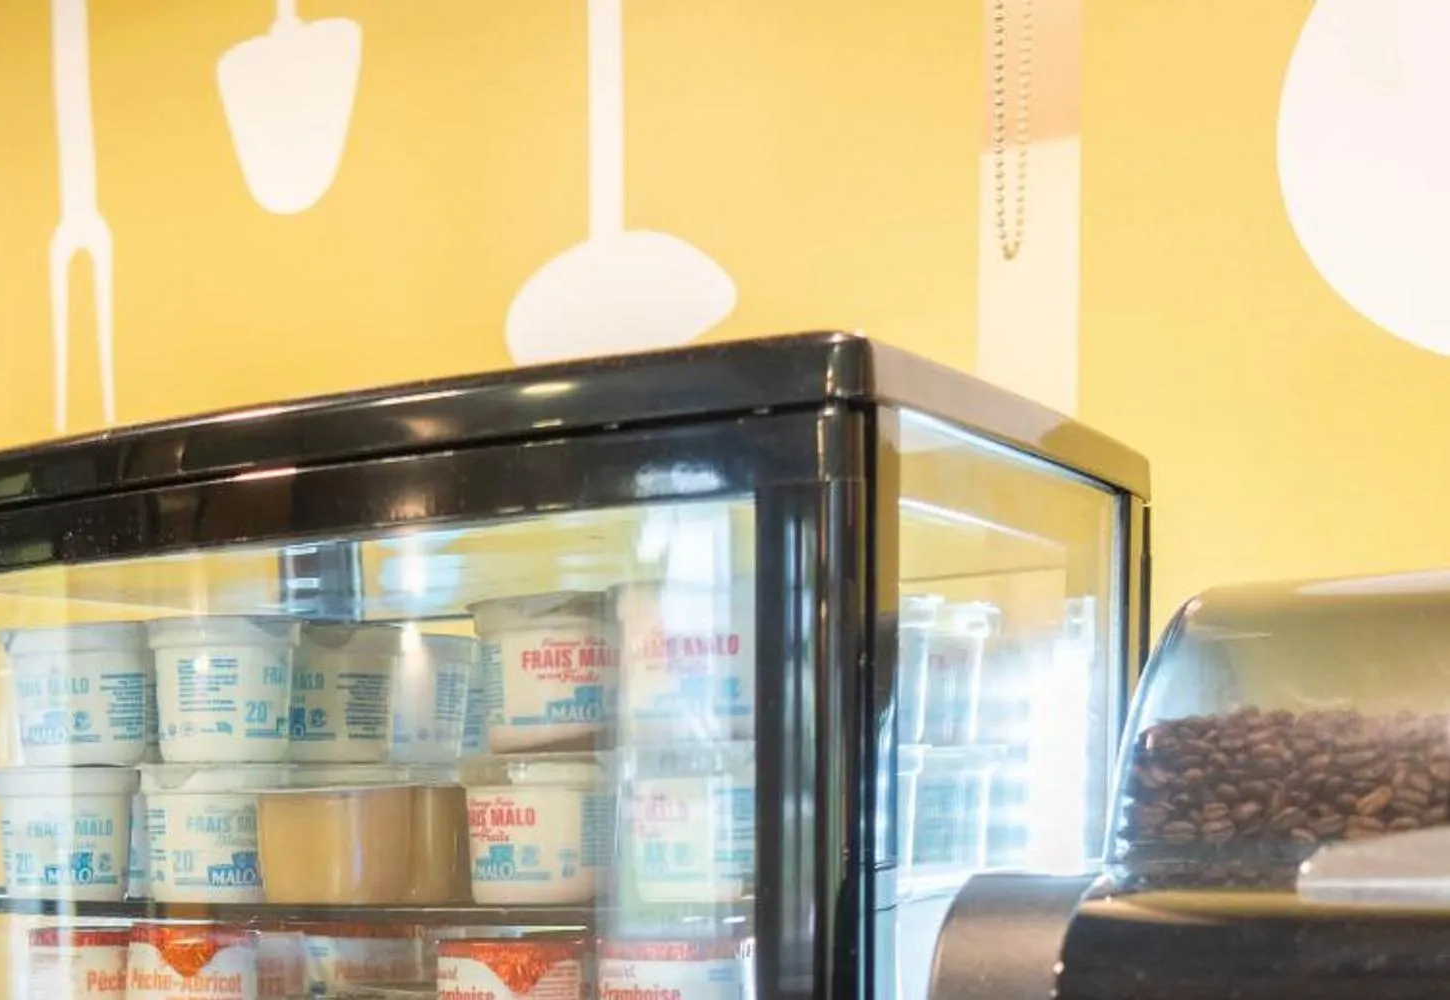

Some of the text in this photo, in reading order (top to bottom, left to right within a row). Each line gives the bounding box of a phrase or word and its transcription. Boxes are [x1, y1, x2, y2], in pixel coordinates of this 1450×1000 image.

[521, 649, 572, 671] FRAIS
[490, 806, 537, 827] MALO
[211, 867, 257, 886] MALO
